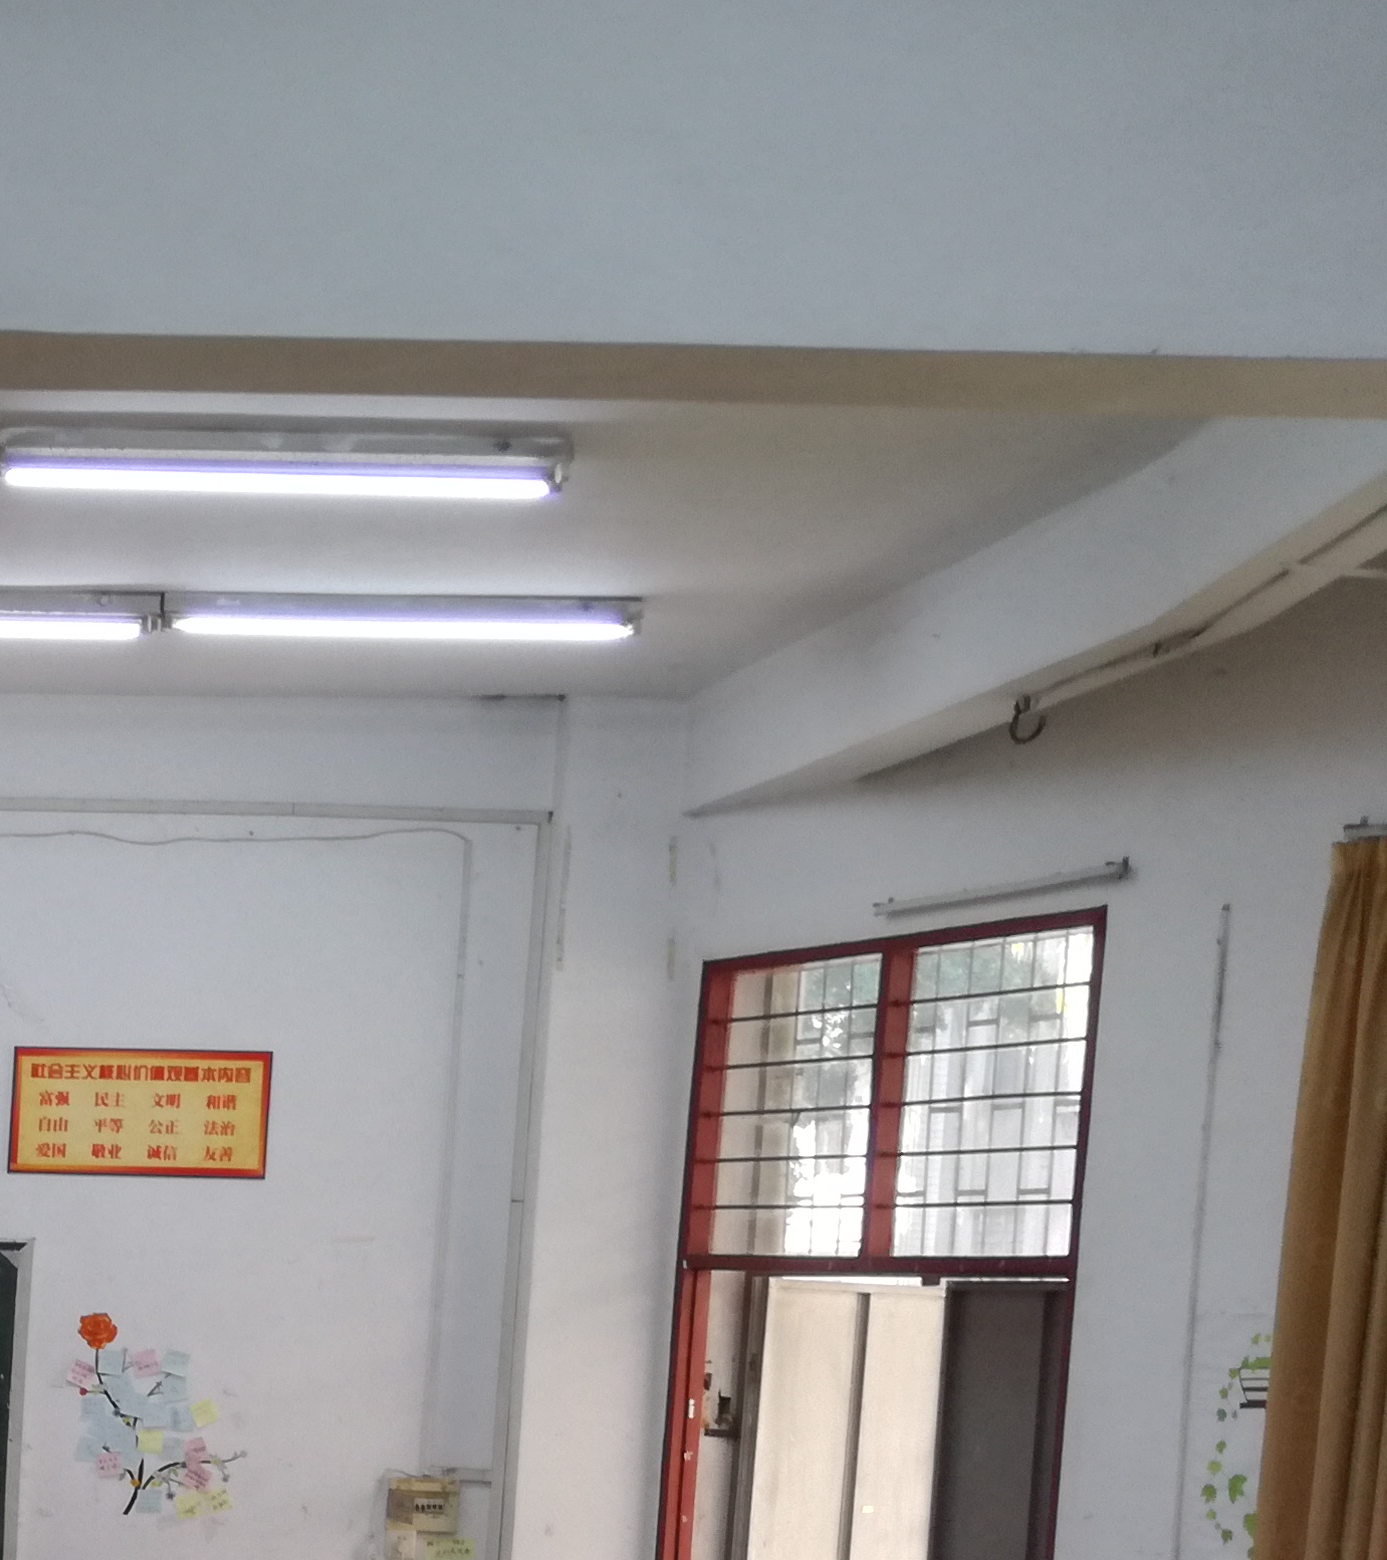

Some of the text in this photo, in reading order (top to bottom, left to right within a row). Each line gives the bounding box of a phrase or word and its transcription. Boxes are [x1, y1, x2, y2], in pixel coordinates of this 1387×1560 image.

[39, 1090, 237, 1110] 富强 民主 文明 和谐
[38, 1117, 235, 1136] 自由 平等 公正 法治
[35, 1142, 233, 1162] 爱国 敬业 诚信 友善
